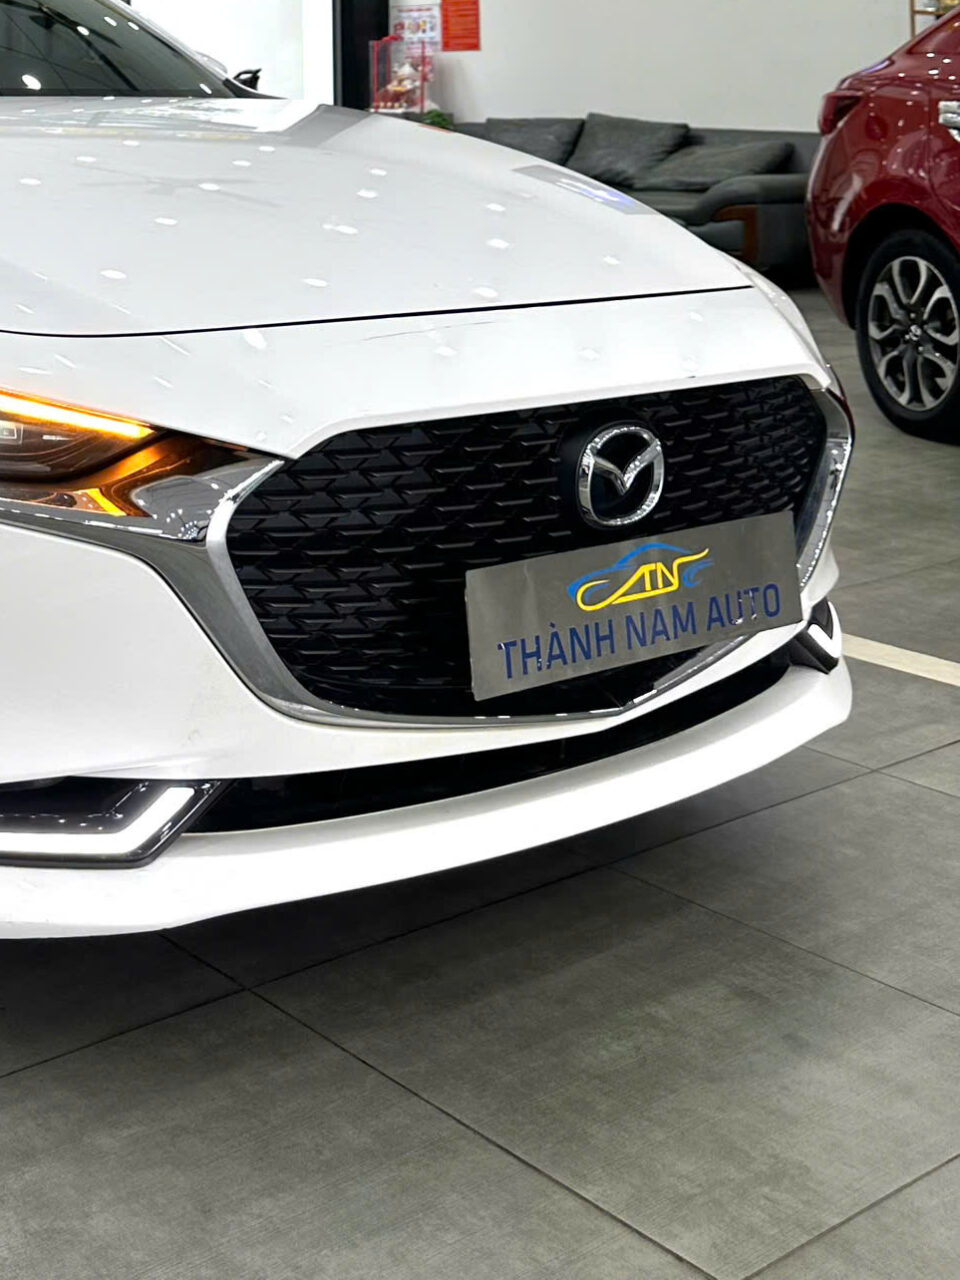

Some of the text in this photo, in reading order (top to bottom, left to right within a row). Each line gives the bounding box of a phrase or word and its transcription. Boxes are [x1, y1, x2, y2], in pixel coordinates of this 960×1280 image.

[497, 583, 781, 680] THÀNH NAM AUTO
